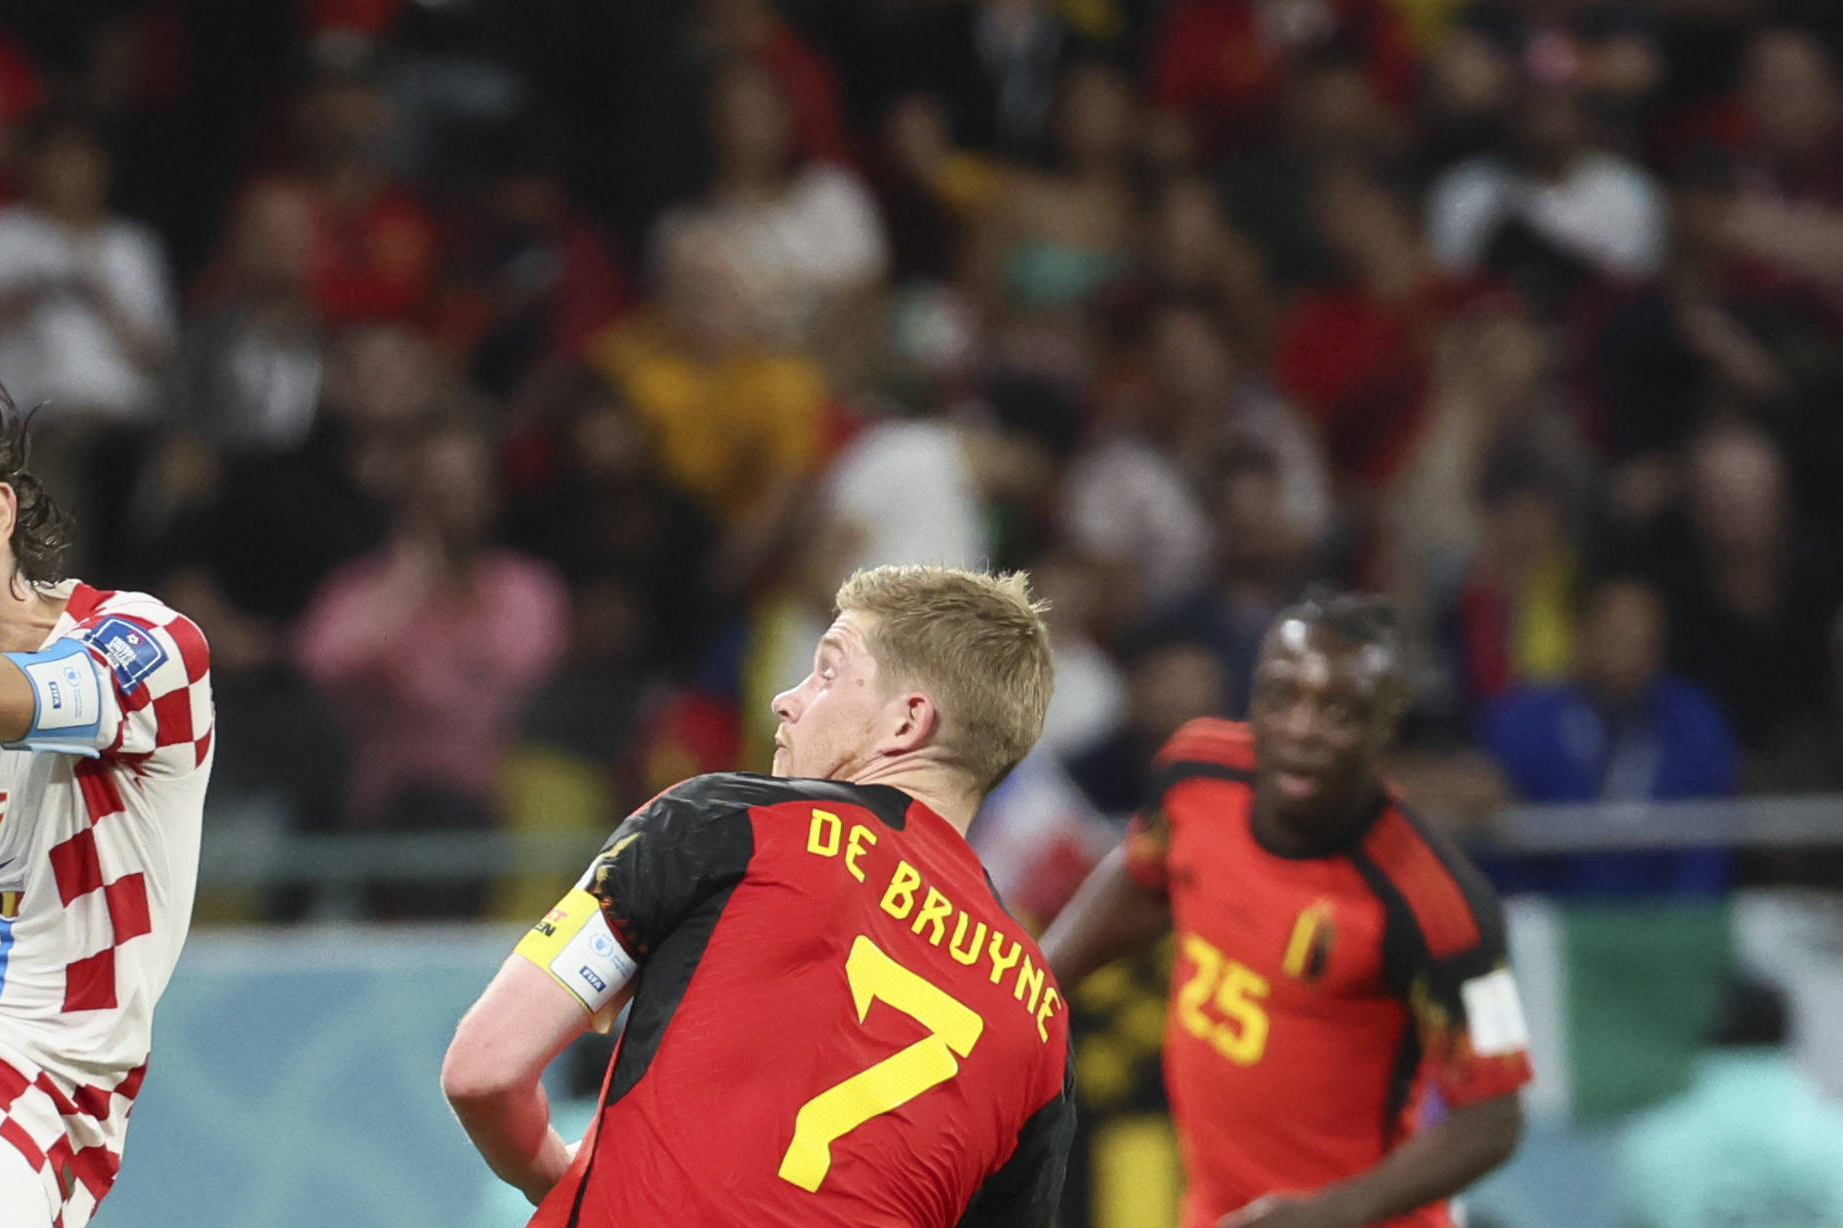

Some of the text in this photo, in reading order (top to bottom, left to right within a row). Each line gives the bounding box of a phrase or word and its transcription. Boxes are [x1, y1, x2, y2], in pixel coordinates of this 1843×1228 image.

[806, 808, 1063, 1044] DE BRUYNE
[1177, 933, 1271, 1065] 25
[777, 933, 985, 1194] 7
